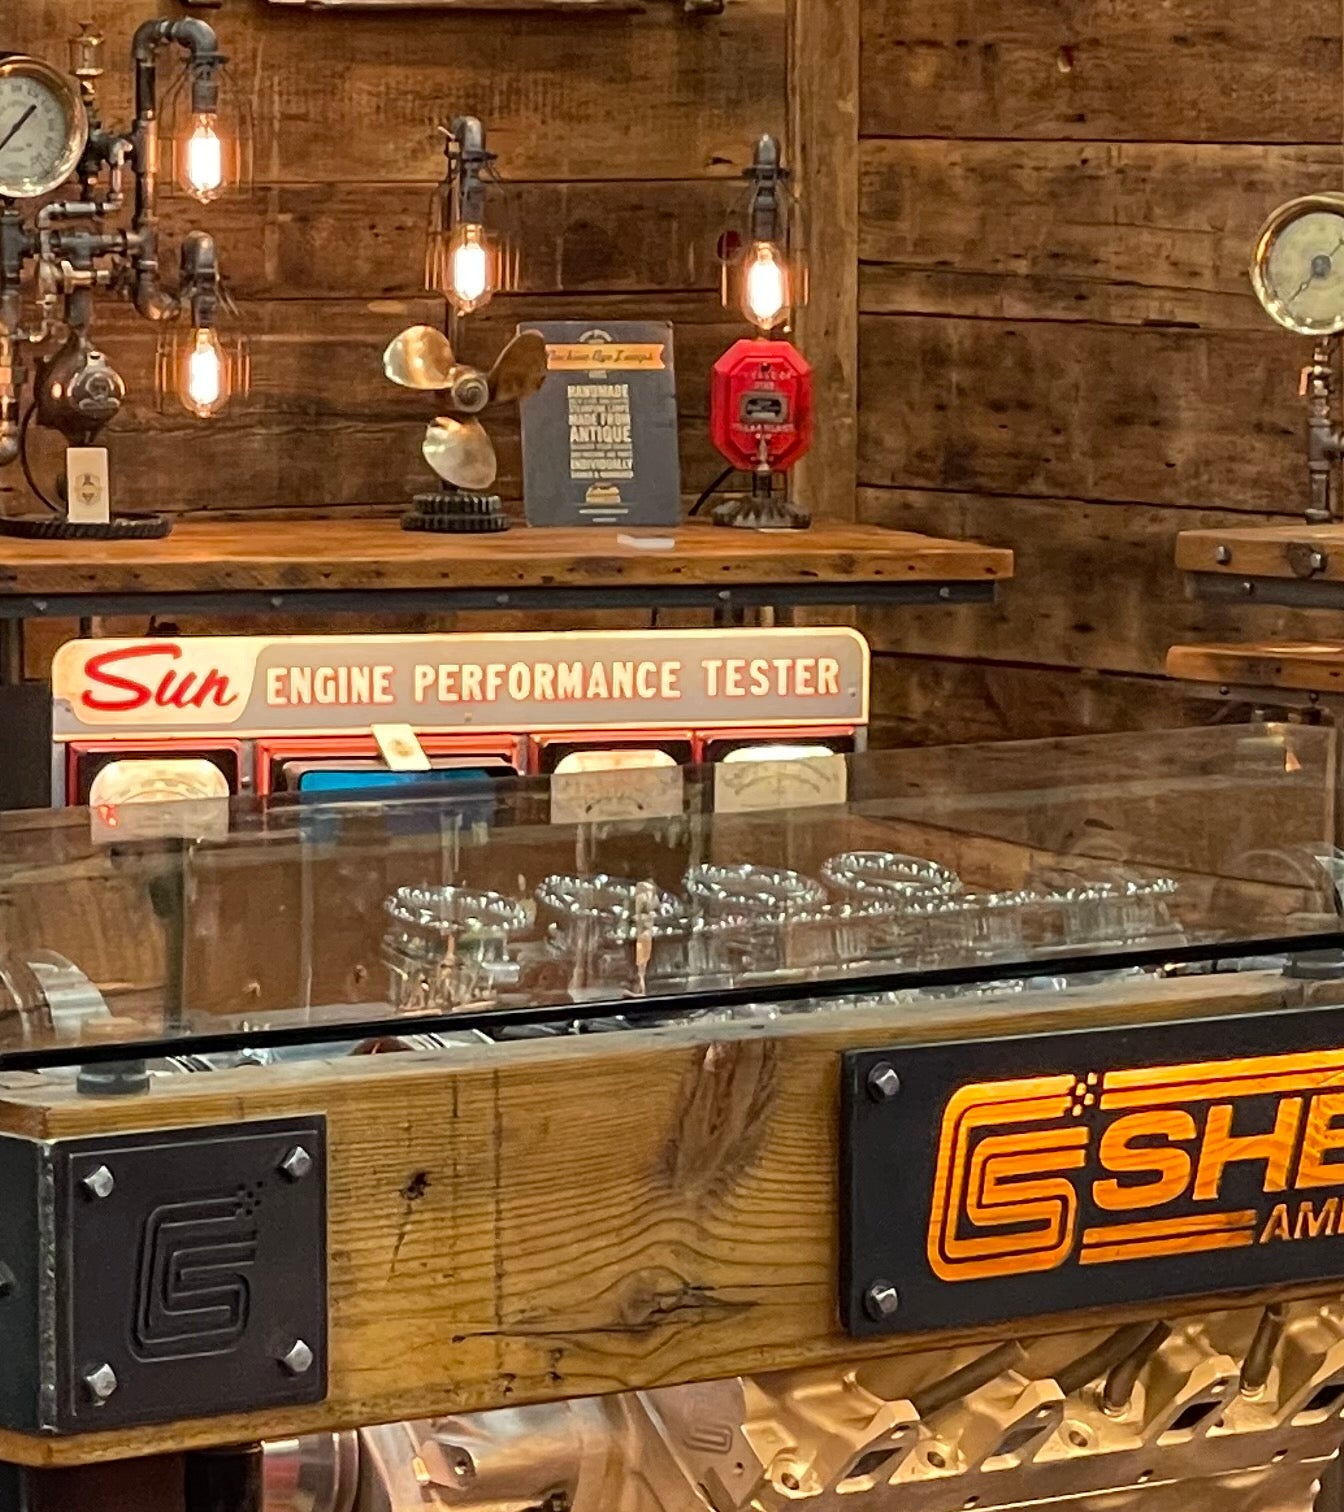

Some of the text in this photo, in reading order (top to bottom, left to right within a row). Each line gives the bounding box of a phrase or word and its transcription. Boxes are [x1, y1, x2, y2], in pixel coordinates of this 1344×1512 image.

[570, 425, 632, 443] ANTIQUE
[81, 643, 842, 712] Sun ENGINE PERFORMANCE TESTER
